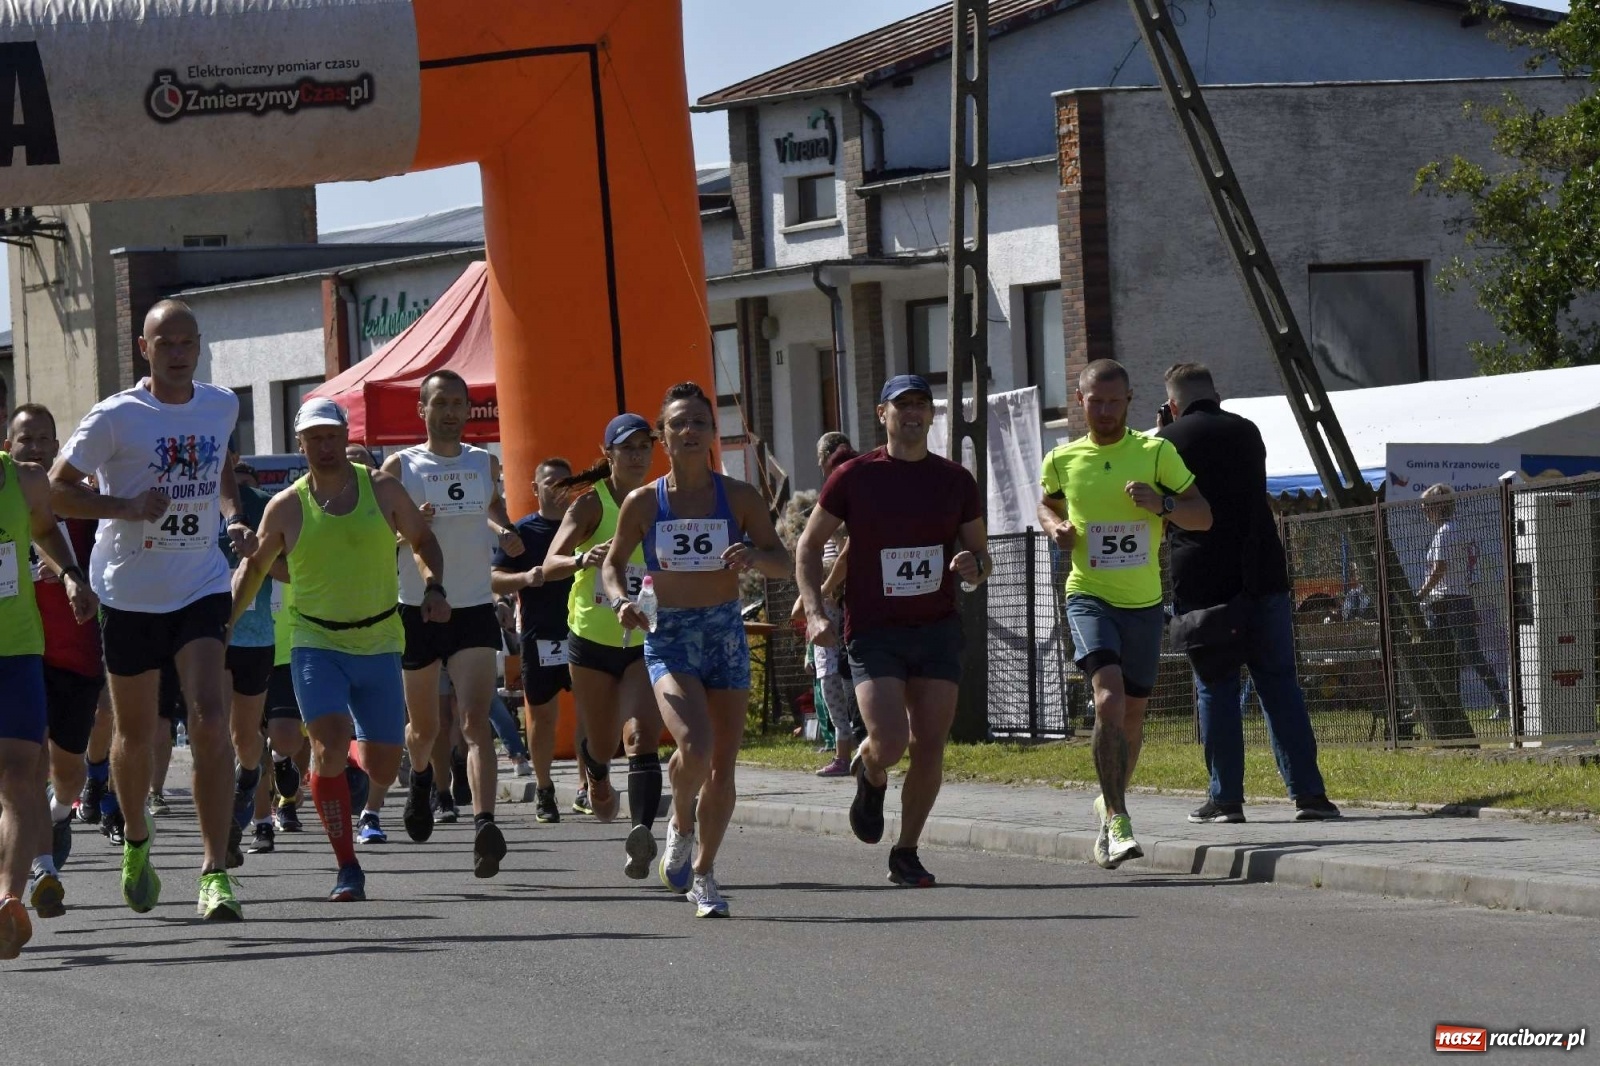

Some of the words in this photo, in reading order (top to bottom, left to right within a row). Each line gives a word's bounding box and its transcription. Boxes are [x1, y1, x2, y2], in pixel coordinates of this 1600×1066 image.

[188, 65, 273, 79] Elektroniczny
[277, 60, 322, 74] pomiar
[325, 59, 360, 71] czasu
[0, 41, 60, 167] A
[186, 79, 369, 111] ZmierzymyCzas.pl
[1406, 460, 1439, 469] Gmina
[1442, 460, 1500, 469] Krzanowice
[447, 483, 465, 501] 6
[160, 513, 199, 536] 48
[661, 523, 699, 532] COLOUR
[704, 523, 722, 531] RUN
[1090, 525, 1126, 533] COLOUR
[673, 533, 713, 555] 36
[1102, 534, 1138, 555] 56
[886, 551, 921, 560] COLOUR
[896, 559, 932, 580] 44
